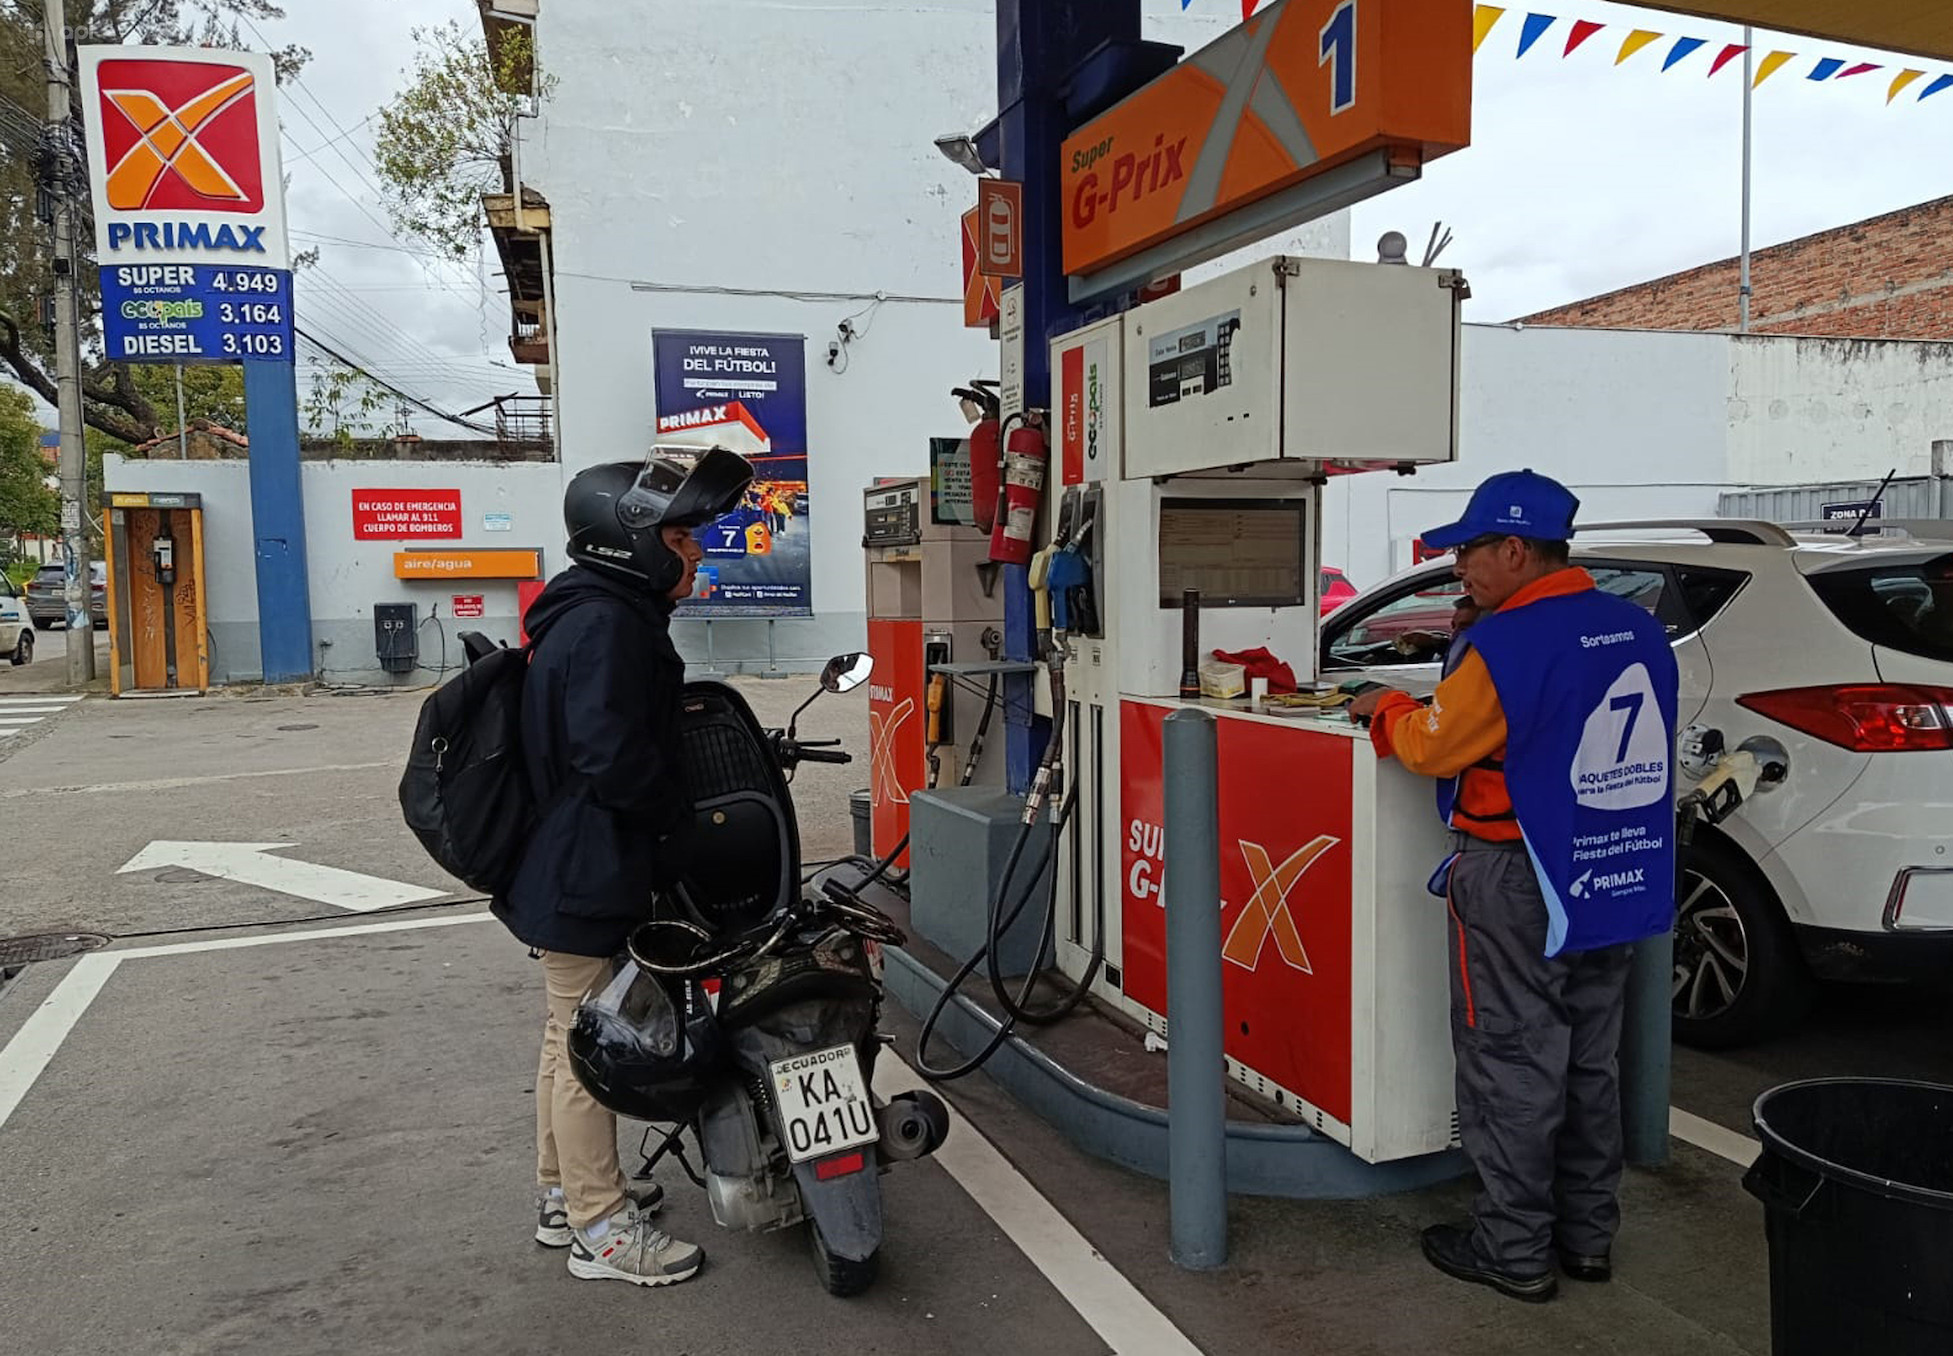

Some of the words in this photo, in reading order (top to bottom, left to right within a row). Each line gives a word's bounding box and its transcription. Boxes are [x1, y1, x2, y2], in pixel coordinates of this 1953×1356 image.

[1319, 1, 1356, 117] 1
[1072, 137, 1114, 173] Super
[1072, 134, 1188, 230] G-Prix
[108, 222, 266, 252] PRIMAX
[118, 266, 196, 287] SUPER
[213, 273, 279, 293] 4.949
[220, 304, 281, 324] 3.164
[124, 336, 202, 356] DIESEL
[223, 334, 282, 354] 3.103
[719, 346, 733, 356] LA
[734, 348, 769, 357] FIESTA
[684, 358, 712, 371] DEL
[715, 357, 776, 373] FÚTBOL!
[660, 406, 727, 429] PRIMAX
[359, 502, 370, 511] EN
[372, 502, 392, 511] CASO
[394, 502, 404, 511] DE
[407, 502, 456, 511] EMERGENCIA
[1830, 510, 1856, 520] ZONA
[364, 524, 395, 532] CUERPO
[397, 524, 407, 532] DE
[410, 524, 453, 532] BOMBEROS
[722, 530, 736, 547] 7
[404, 560, 472, 570] aire/agua
[1580, 630, 1635, 648] Sorteamos
[1610, 692, 1644, 764] 7
[1624, 762, 1663, 776] DOBLES
[1608, 843, 1624, 856] del
[1625, 837, 1663, 853] Fútbol
[1593, 868, 1644, 891] PRIMAX
[782, 1050, 845, 1072] ECUADOR
[798, 1068, 841, 1108] KA
[790, 1100, 870, 1152] 041U
